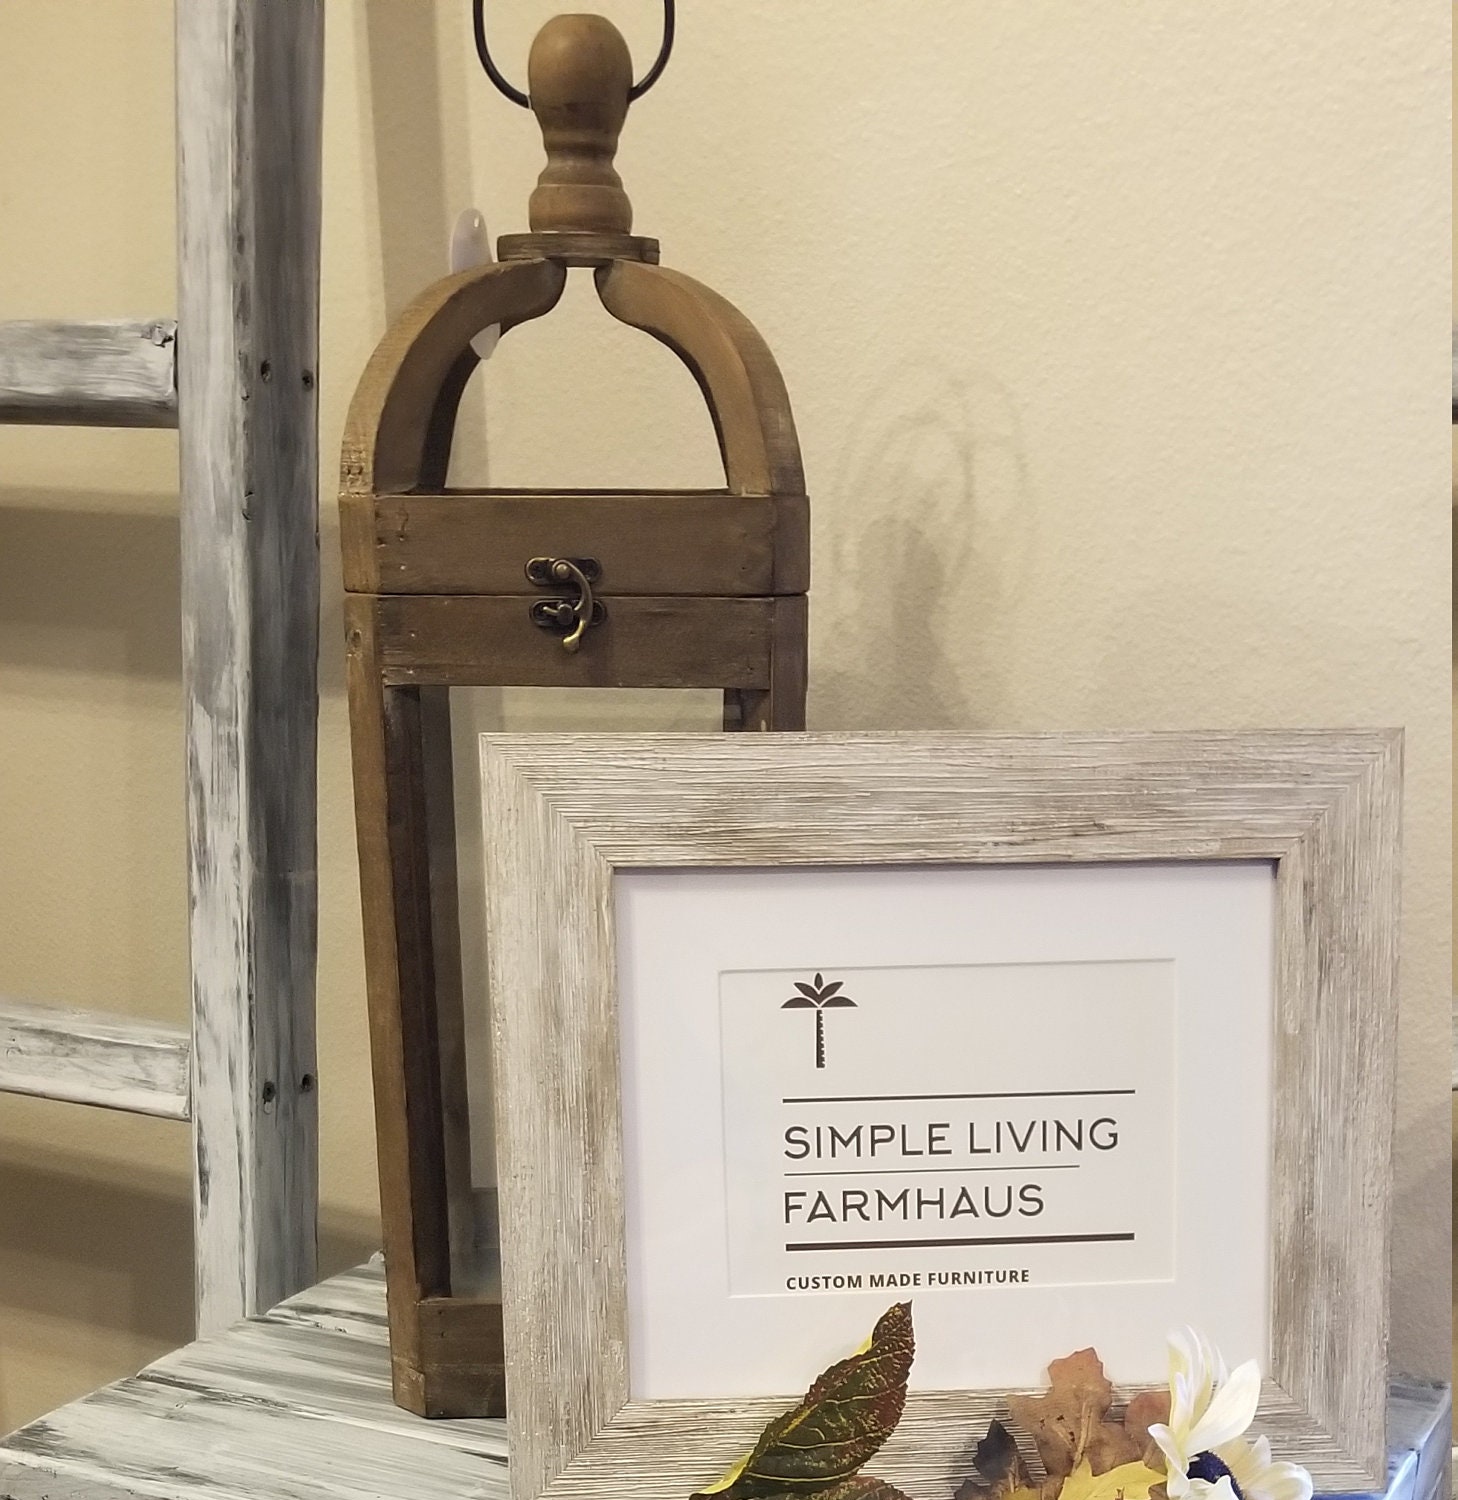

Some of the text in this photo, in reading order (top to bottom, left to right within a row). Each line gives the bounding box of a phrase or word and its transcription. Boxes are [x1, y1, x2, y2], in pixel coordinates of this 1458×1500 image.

[784, 1117, 1119, 1160] SIMPLE LIVING
[784, 1184, 1044, 1224] FARMHAUS
[786, 1269, 1030, 1290] CUSTOM MADE FURNITURE
